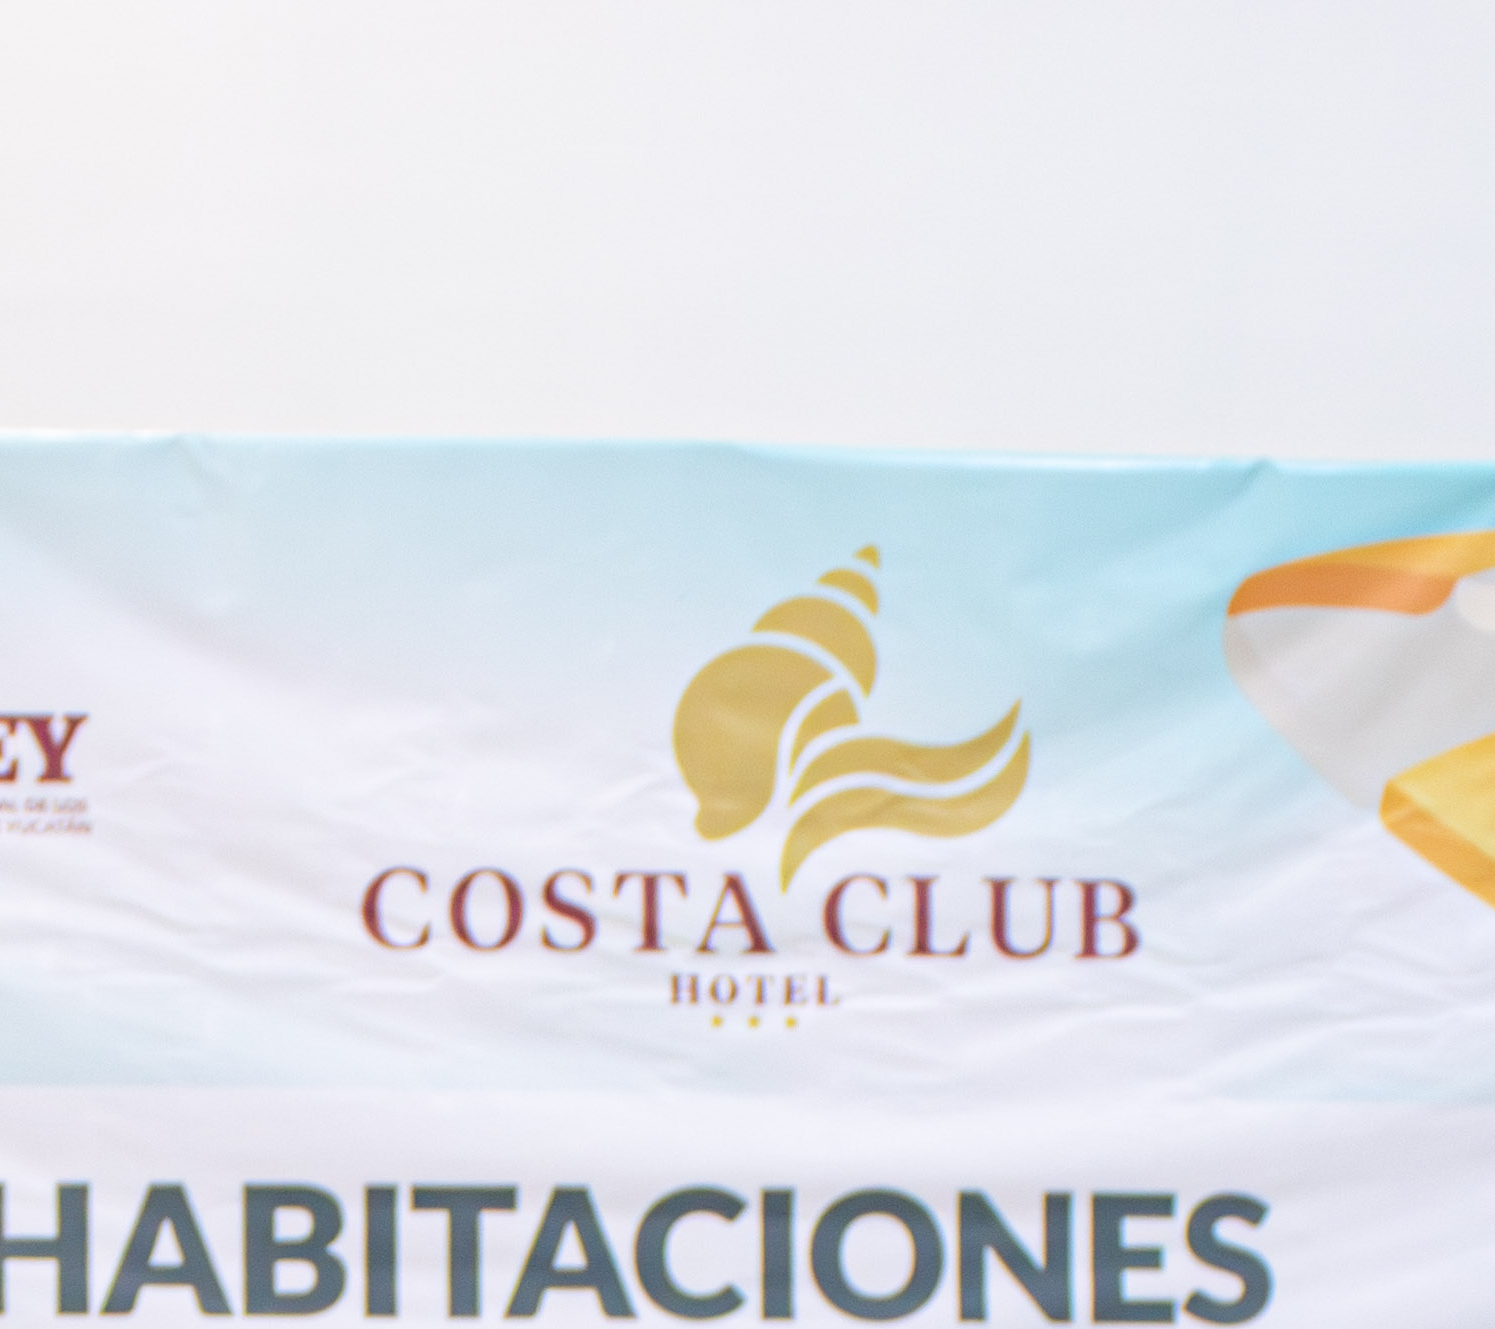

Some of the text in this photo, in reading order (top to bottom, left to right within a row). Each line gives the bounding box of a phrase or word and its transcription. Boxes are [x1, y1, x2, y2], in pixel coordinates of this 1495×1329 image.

[361, 866, 1141, 961] COSTA CLUB
[668, 972, 841, 1007] HOTEL
